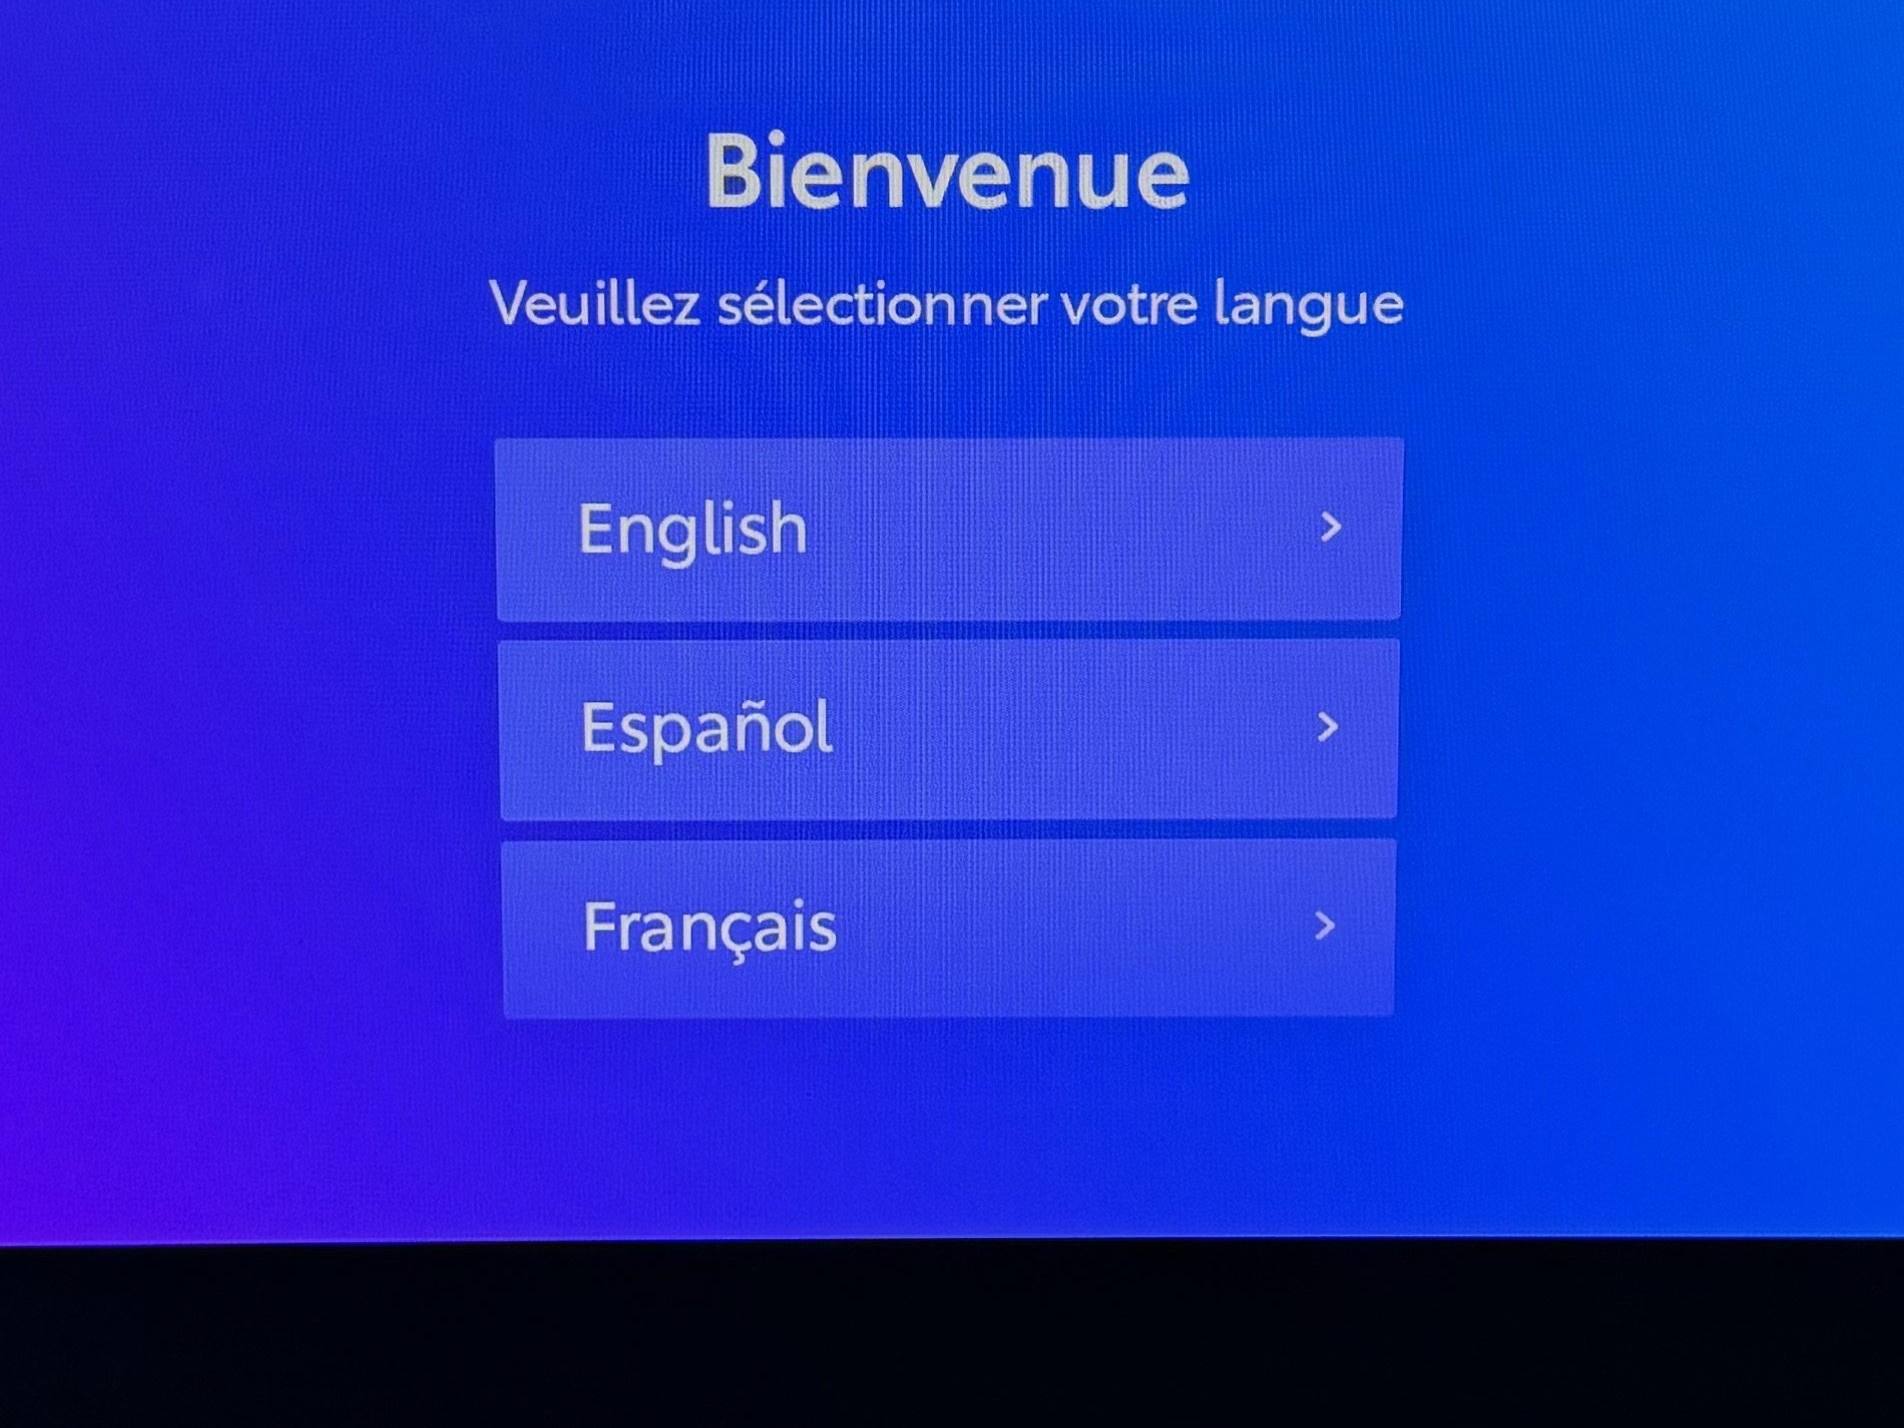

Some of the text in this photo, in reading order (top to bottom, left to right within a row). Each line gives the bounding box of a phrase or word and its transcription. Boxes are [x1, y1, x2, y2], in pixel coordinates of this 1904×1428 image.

[706, 128, 1191, 211] Bienvenue
[487, 276, 1406, 340] Veuillez sélectionner votre langue
[579, 498, 807, 571] English
[582, 697, 834, 767] Español
[584, 897, 839, 967] Français
